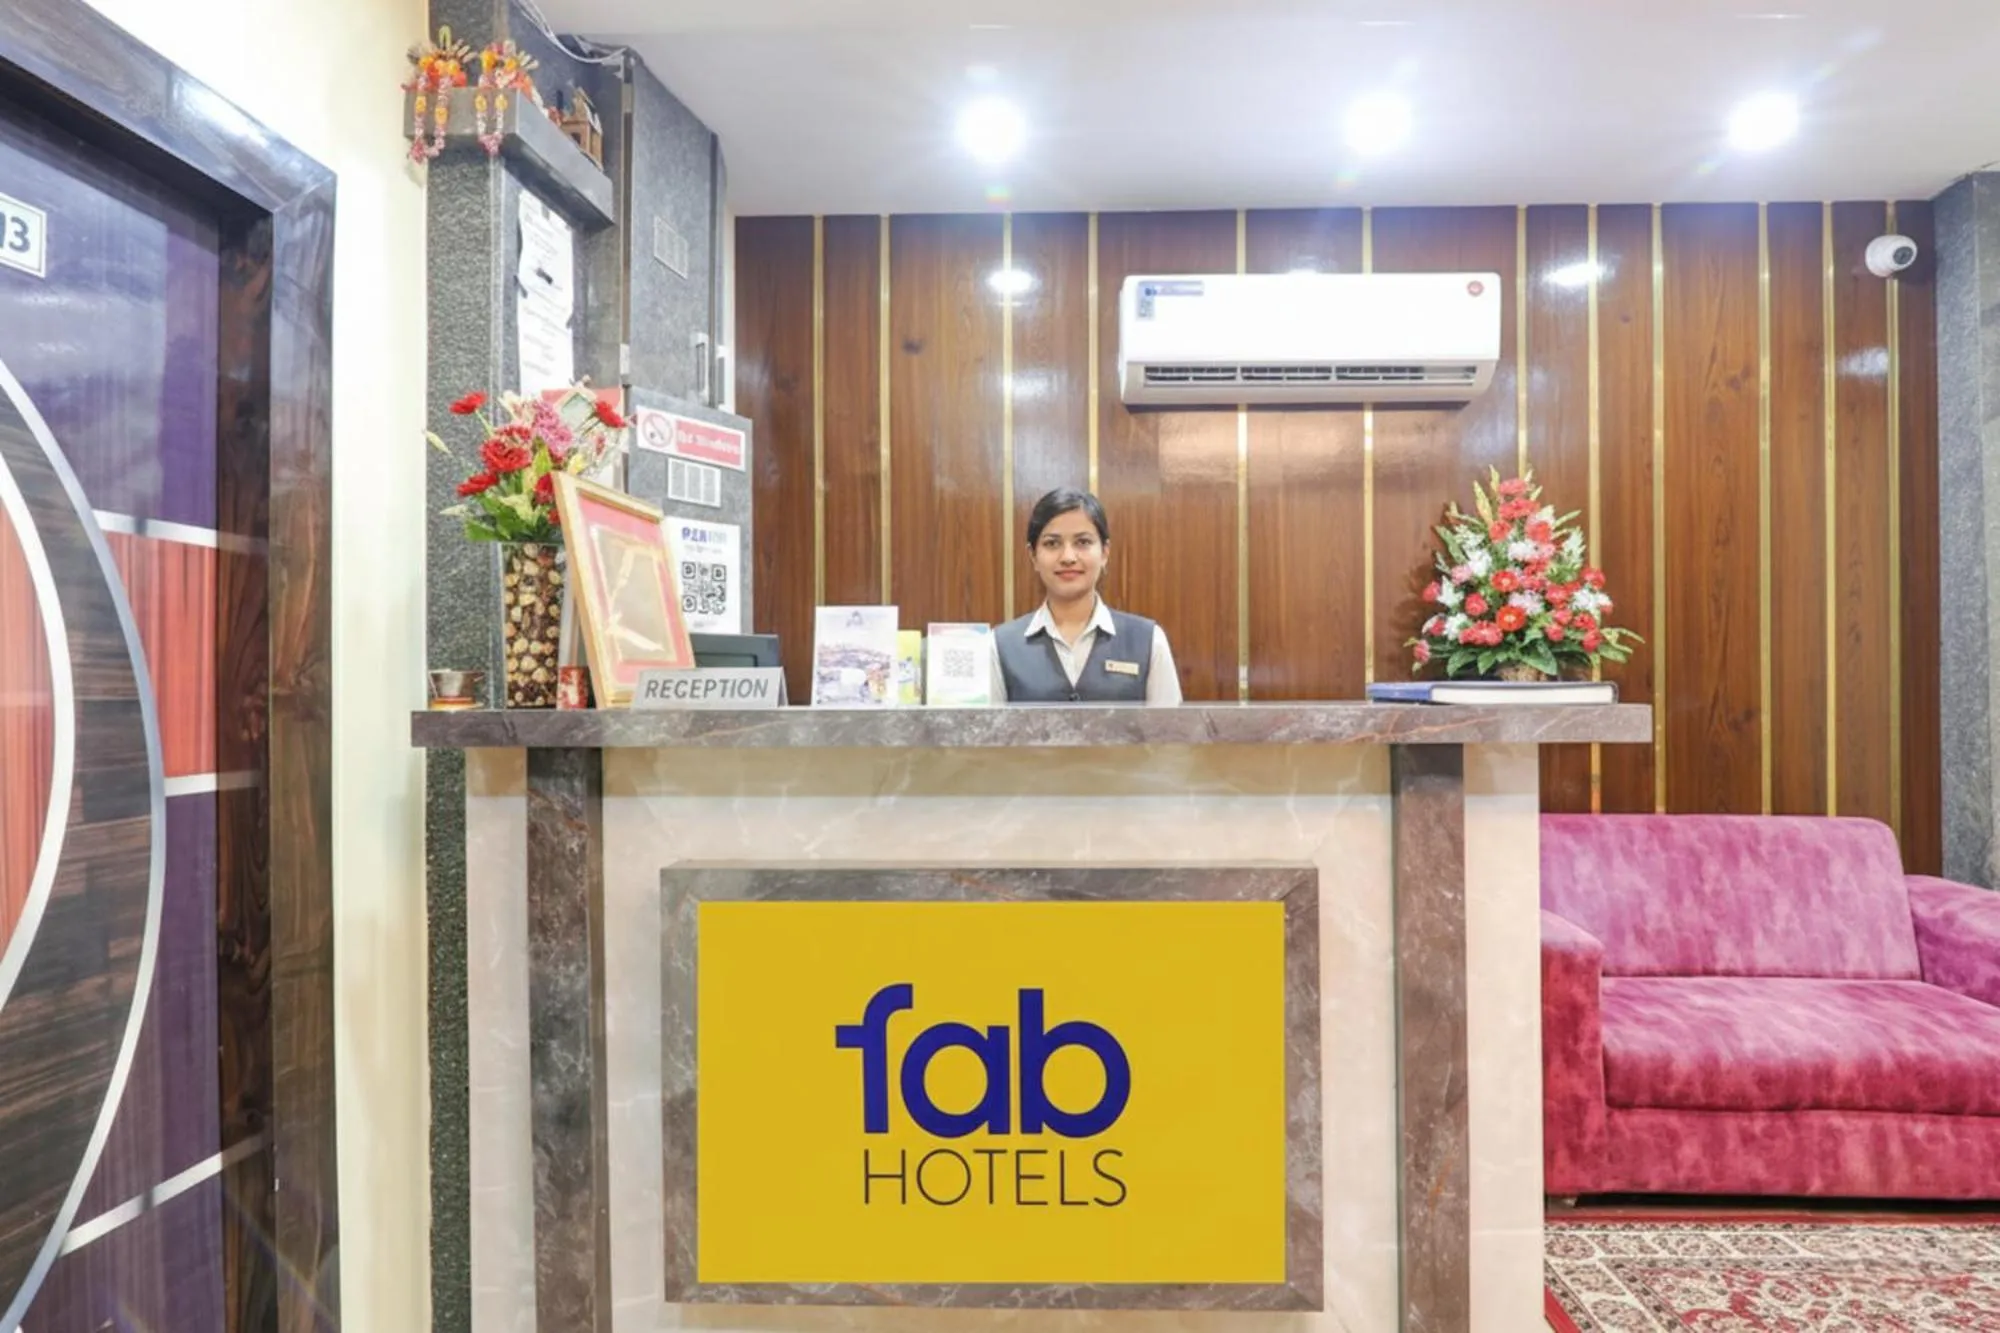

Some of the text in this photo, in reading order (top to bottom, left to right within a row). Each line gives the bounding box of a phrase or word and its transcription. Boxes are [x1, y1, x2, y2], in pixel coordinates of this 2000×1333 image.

[645, 678, 769, 698] RECEPTION
[835, 983, 1131, 1138] fab
[864, 1149, 1126, 1207] HOTELS
